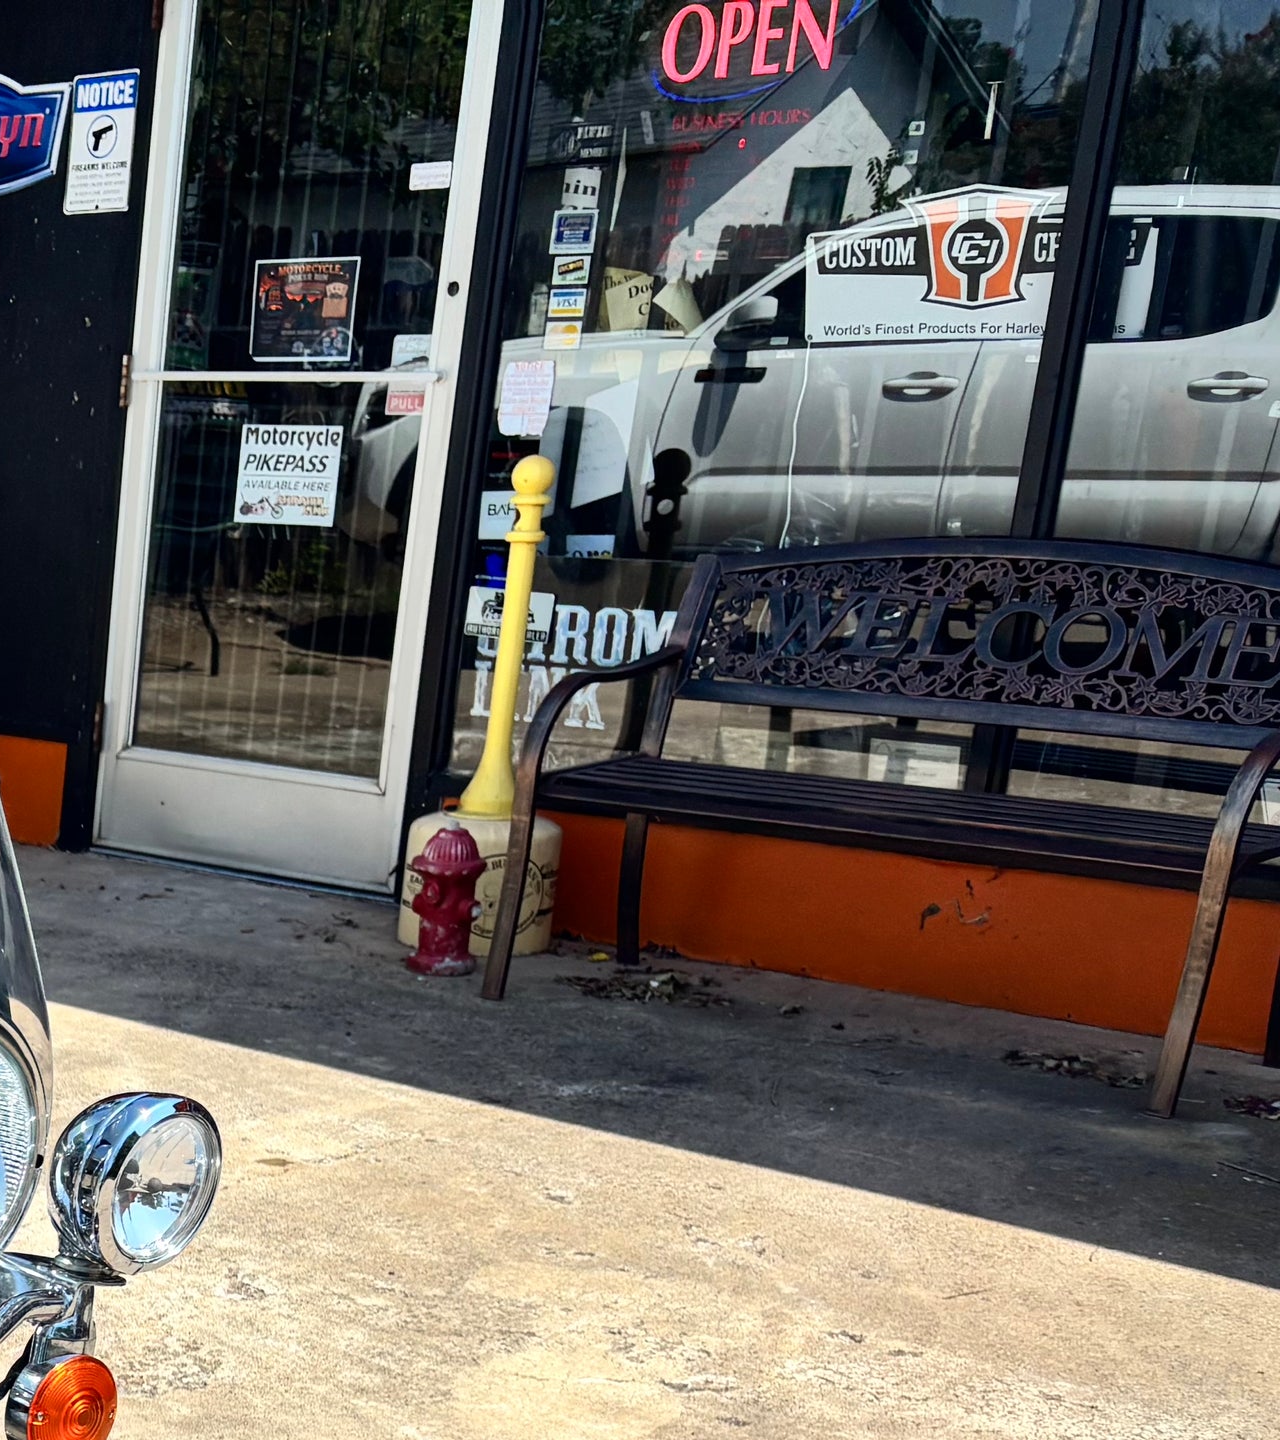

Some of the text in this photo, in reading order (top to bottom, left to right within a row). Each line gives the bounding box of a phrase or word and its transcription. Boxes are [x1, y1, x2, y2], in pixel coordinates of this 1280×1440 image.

[662, 0, 839, 83] OPEN
[76, 79, 135, 109] NOTICE
[824, 236, 917, 270] CUSTOM
[278, 264, 342, 276] MOTORCYCLE
[557, 299, 578, 307] VISA
[823, 324, 871, 336] World's
[875, 323, 914, 335] Finest
[918, 322, 977, 334] Products
[981, 322, 1001, 334] For
[389, 396, 422, 411] PULL
[245, 427, 341, 451] Motorcycle
[244, 453, 329, 473] PIKEPASS
[243, 480, 330, 492] AVAILABLE HERE
[752, 588, 1280, 688] WELCOME
